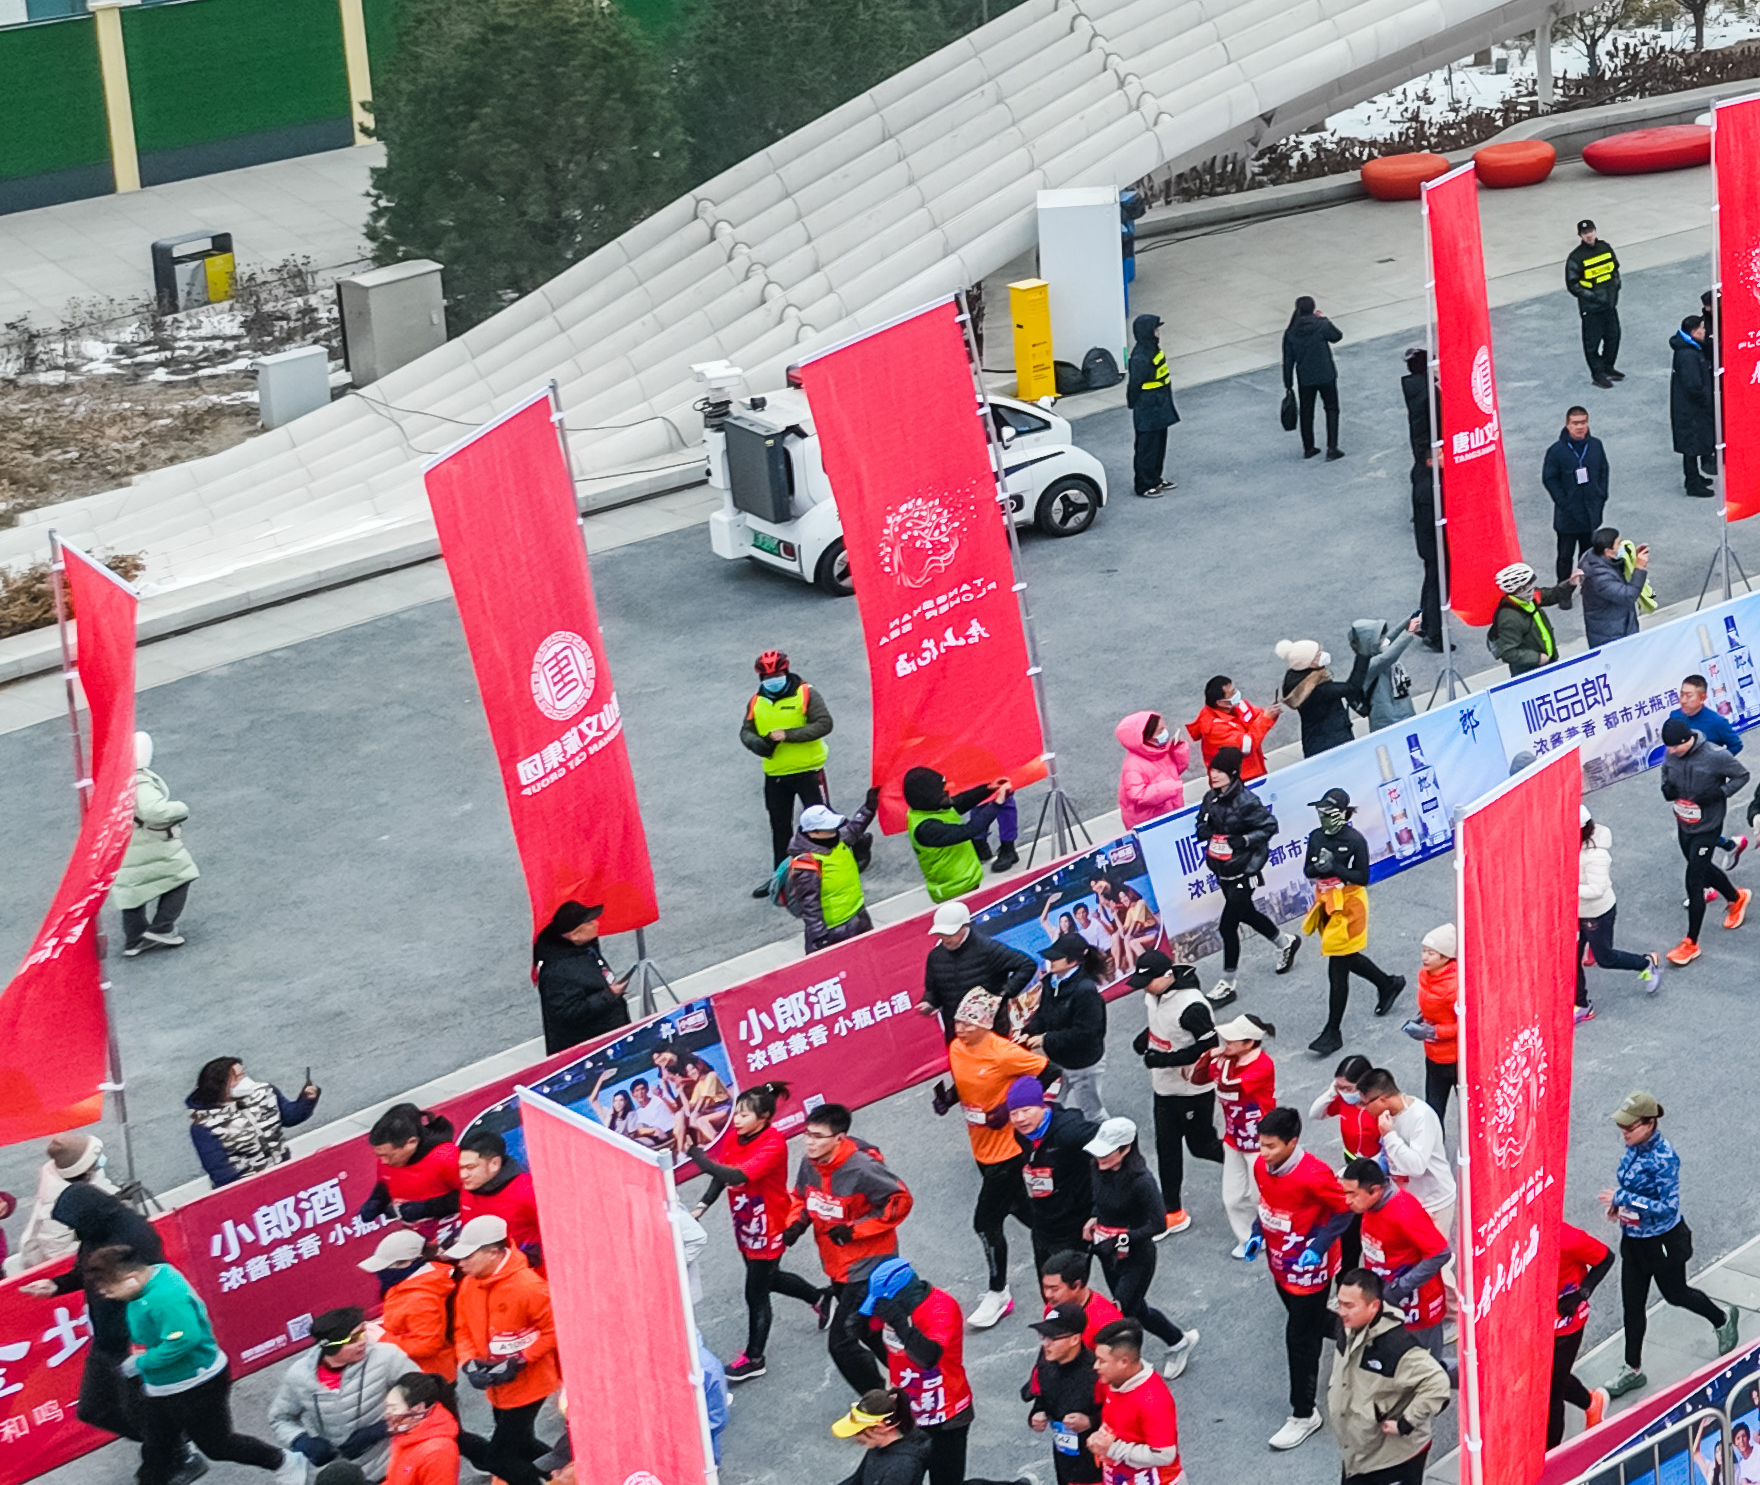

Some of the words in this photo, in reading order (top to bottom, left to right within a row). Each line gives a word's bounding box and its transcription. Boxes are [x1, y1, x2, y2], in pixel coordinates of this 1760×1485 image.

[1522, 672, 1613, 735] 顺品郎
[1604, 686, 1680, 731] 都市光瓶酒
[738, 974, 848, 1047] 小郎酒
[747, 1024, 829, 1073] 浓酱兼香
[833, 990, 913, 1036] 小瓶白酒
[209, 1177, 346, 1263] 小郎酒
[218, 1232, 323, 1293] 浓酱兼香
